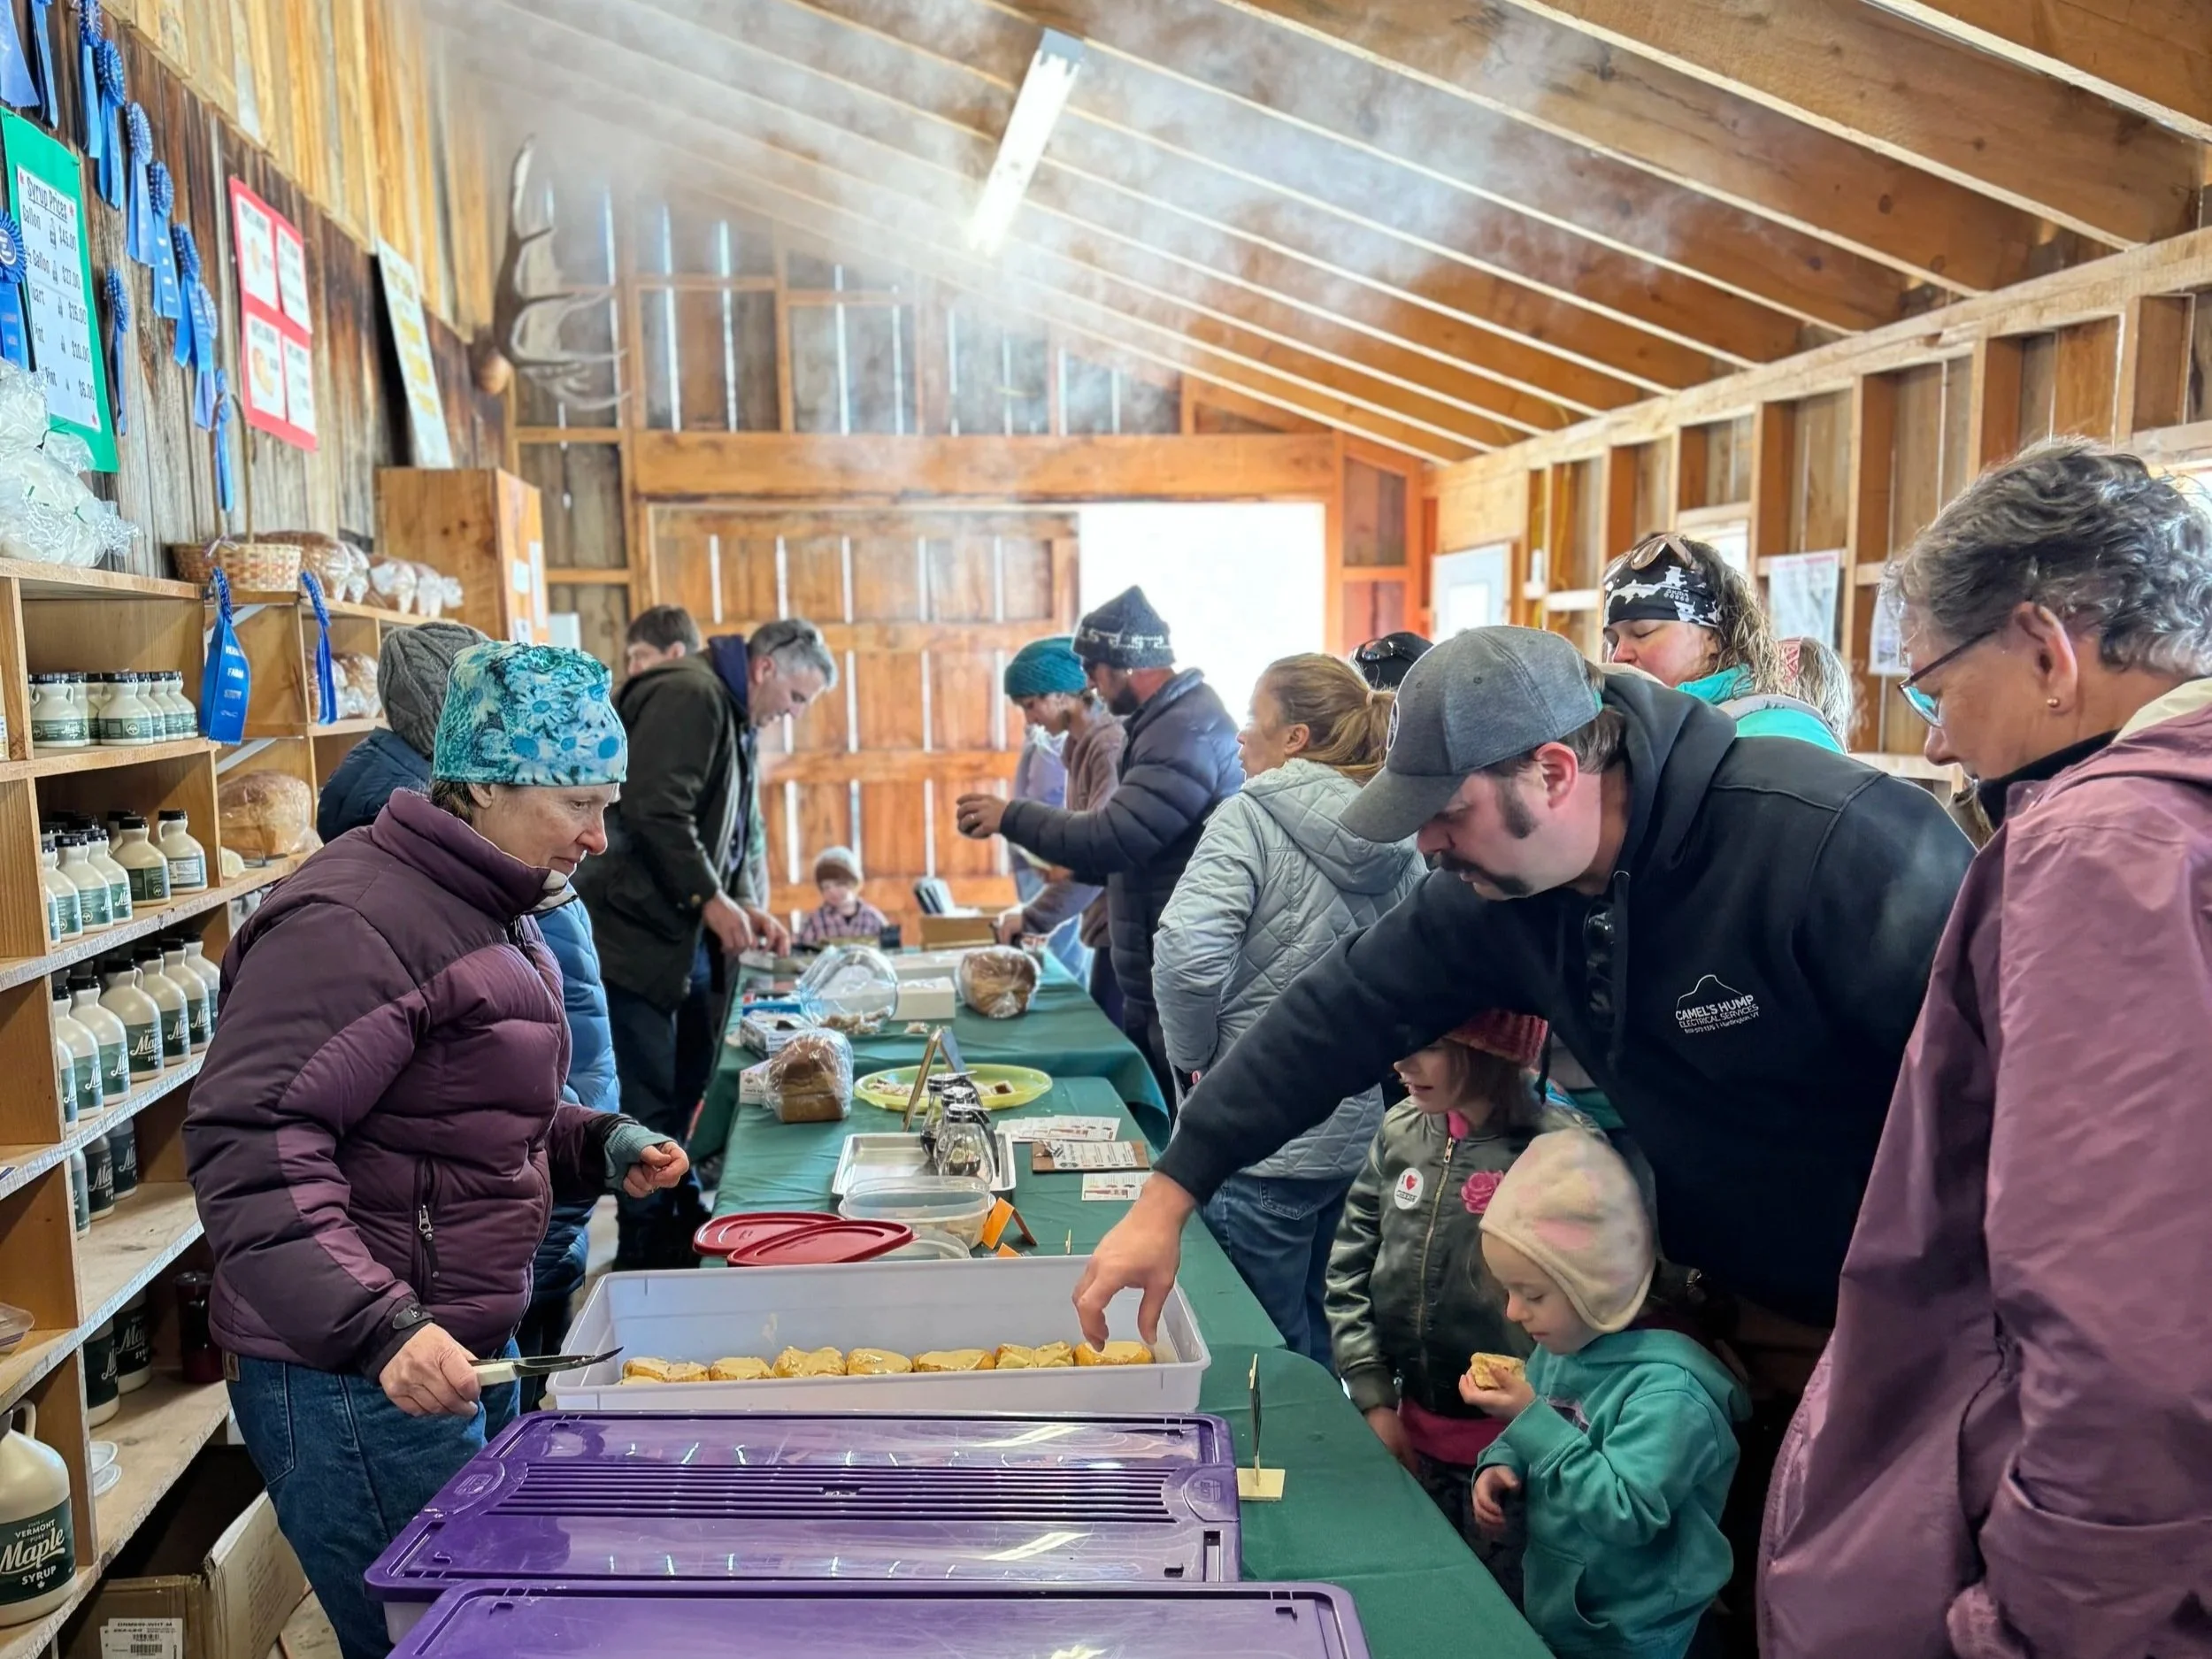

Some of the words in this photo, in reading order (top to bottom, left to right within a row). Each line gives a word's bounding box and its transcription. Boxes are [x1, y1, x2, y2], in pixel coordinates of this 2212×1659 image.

[27, 176, 48, 210] Syrup
[22, 204, 41, 230] Gallon
[1675, 1005, 1718, 1021] CAMEL'S
[1717, 995, 1754, 1012] HUMP
[1678, 1015, 1721, 1028] ELECTRICAL
[1720, 1003, 1759, 1020] SERVICES
[14, 1518, 56, 1538] VERMONT
[0, 1527, 65, 1574] Maple
[21, 1565, 57, 1585] SYRUP
